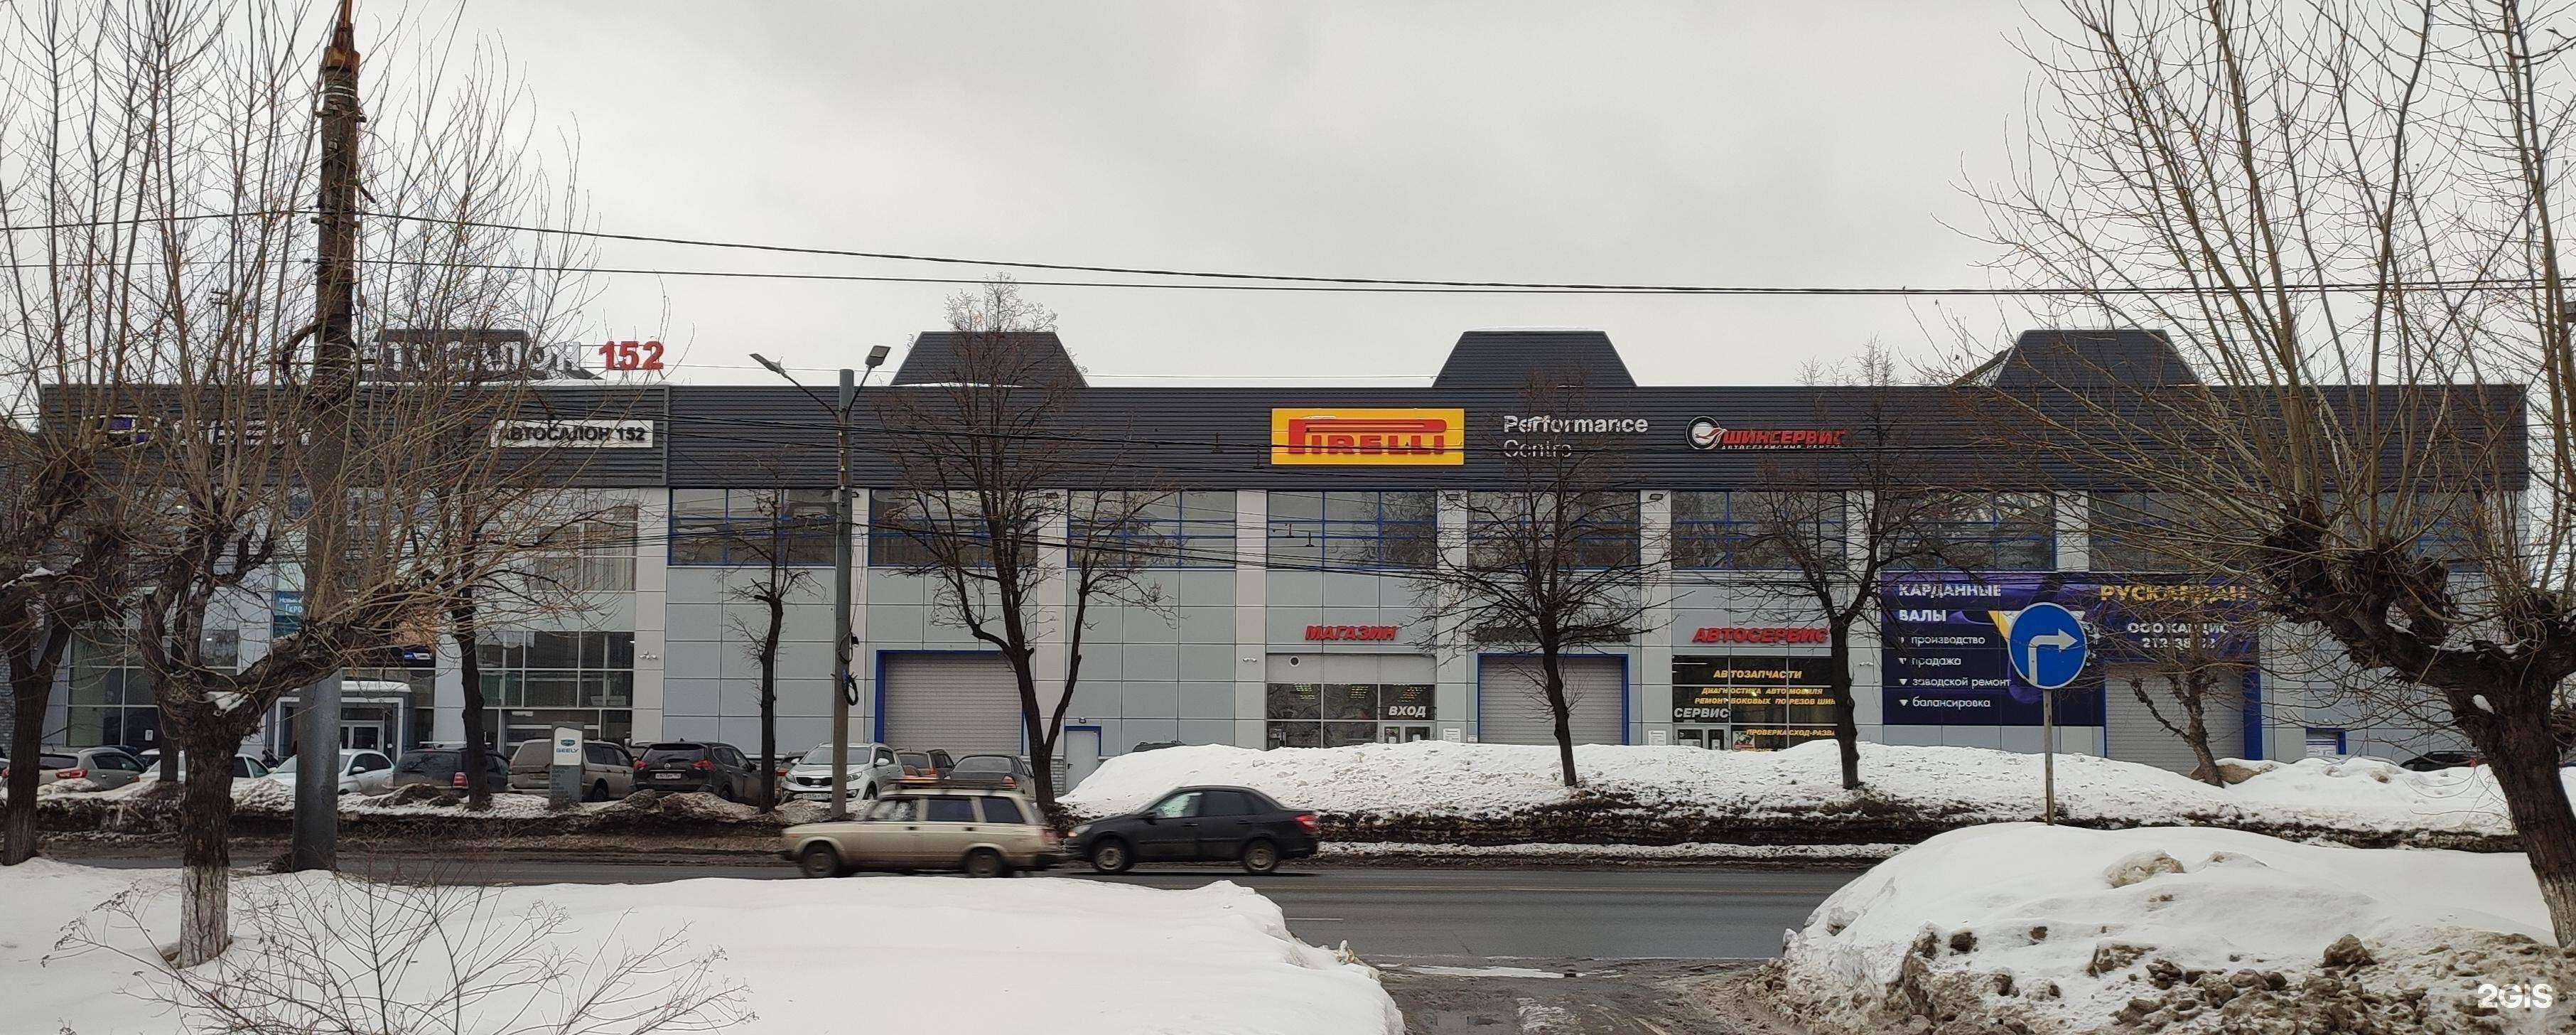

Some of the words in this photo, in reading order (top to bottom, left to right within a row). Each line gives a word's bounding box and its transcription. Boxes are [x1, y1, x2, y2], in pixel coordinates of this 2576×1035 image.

[598, 340, 664, 370] 152
[1504, 415, 1649, 433] Performance
[616, 428, 645, 441] 152
[1288, 419, 1447, 454] PIRELLI
[1504, 439, 1573, 458] Centre
[1899, 584, 2001, 598] КАРДАННЫЕ
[1899, 609, 1946, 621] ВАЛЫ
[1305, 625, 1398, 640] МАГАЗИН
[1692, 627, 1828, 643] АВТОСЕРВИС
[1911, 636, 1985, 646] производство
[1912, 658, 1961, 668] продажа
[1713, 670, 1802, 679] АВТОЗАПЧАСТИ
[1912, 677, 1968, 687] заводской
[1971, 679, 2012, 690] ремонт
[1912, 696, 1990, 710] балансировка
[1389, 705, 1427, 718] ВХОД
[1674, 707, 1729, 719] СЕРВИС
[1788, 729, 1835, 737] СХОД-РАЗВ
